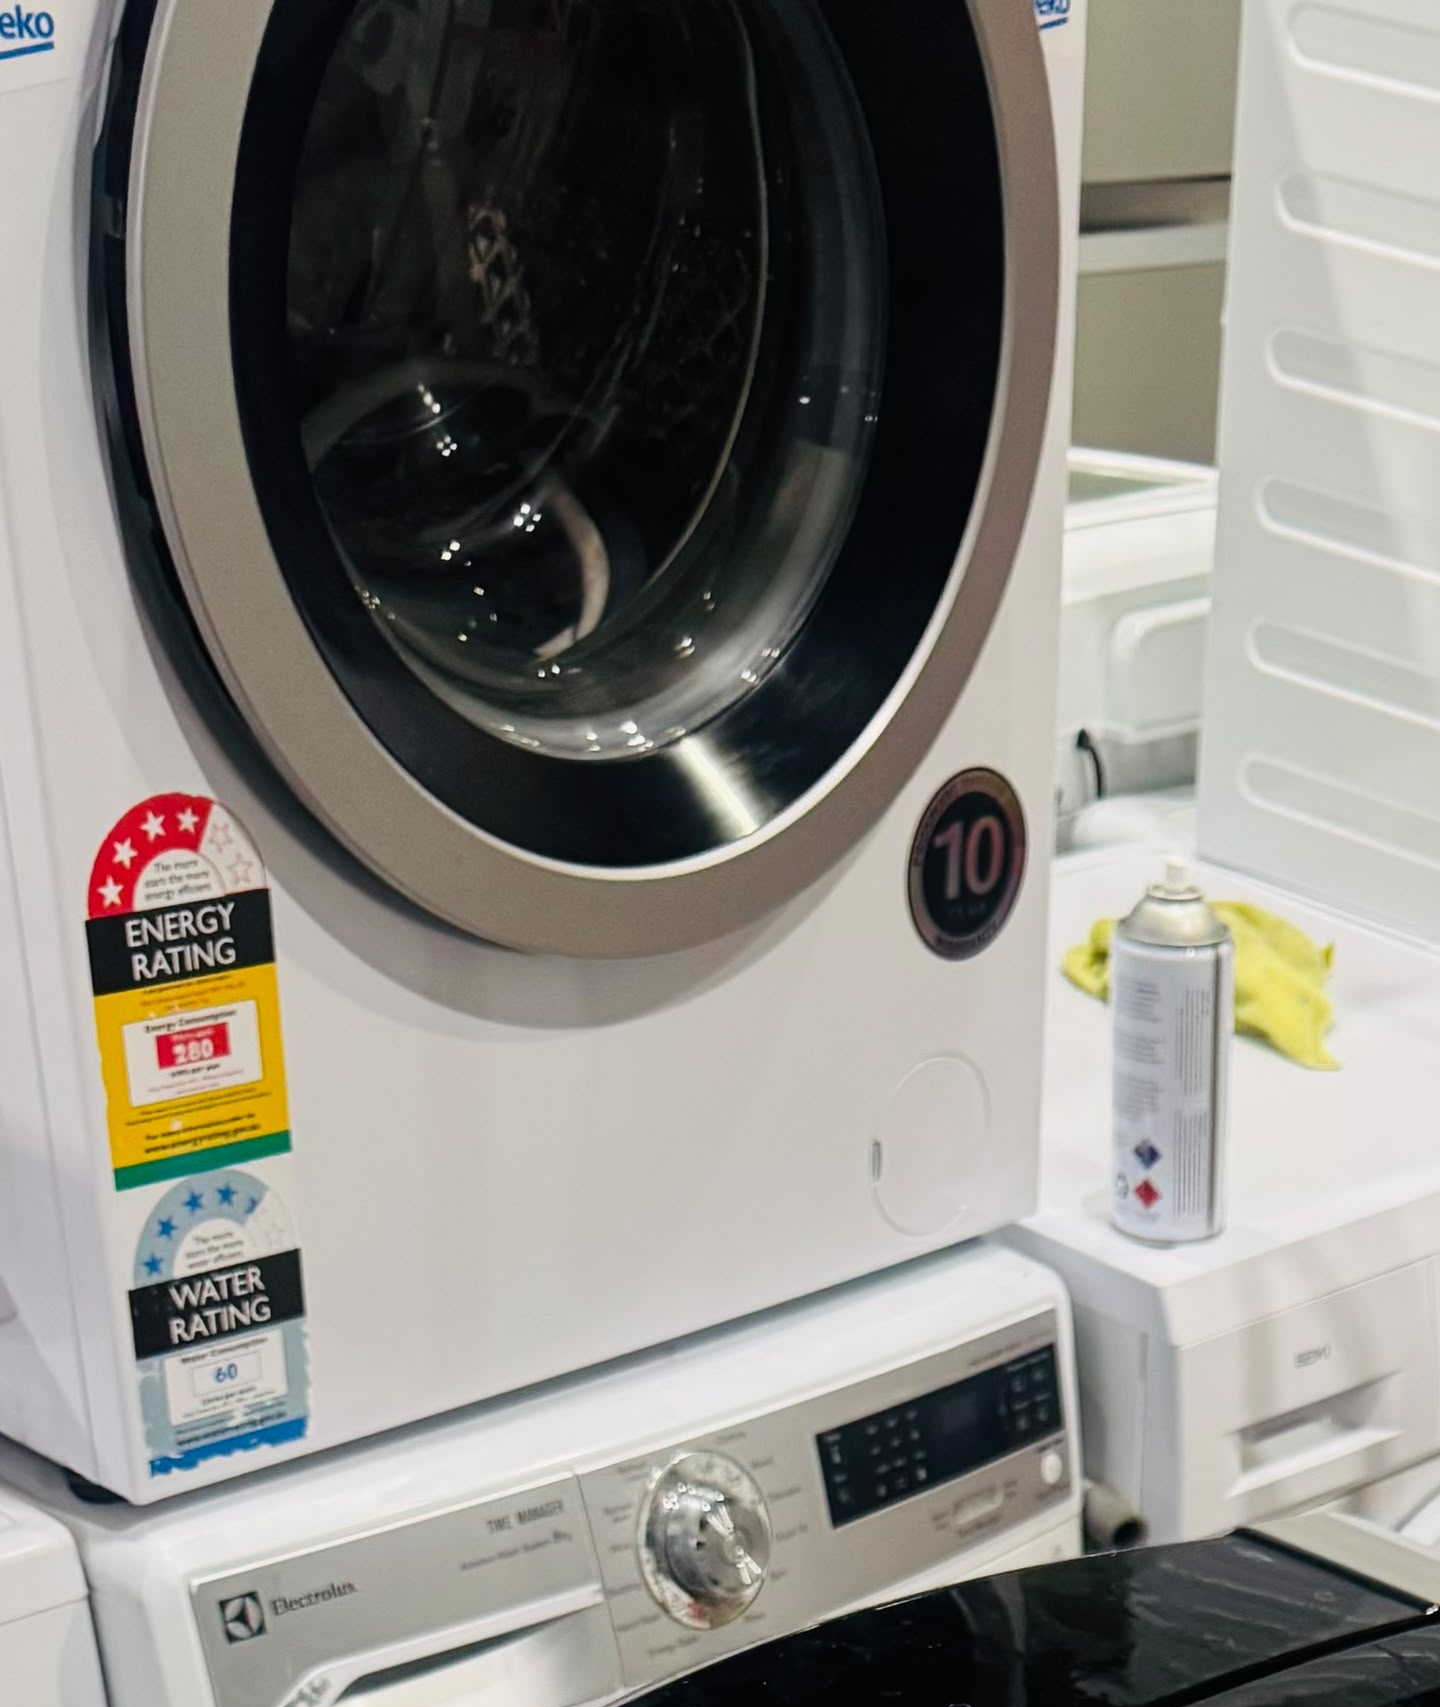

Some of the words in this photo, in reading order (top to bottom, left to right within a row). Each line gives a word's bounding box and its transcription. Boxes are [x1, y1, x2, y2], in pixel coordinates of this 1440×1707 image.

[933, 816, 1005, 900] 10
[124, 902, 236, 948] ENERGY
[131, 937, 237, 981] RATING
[168, 1265, 266, 1312] WATER
[168, 1296, 272, 1345] RATING
[214, 1363, 239, 1384] 60
[272, 1580, 358, 1617] Electrolux
